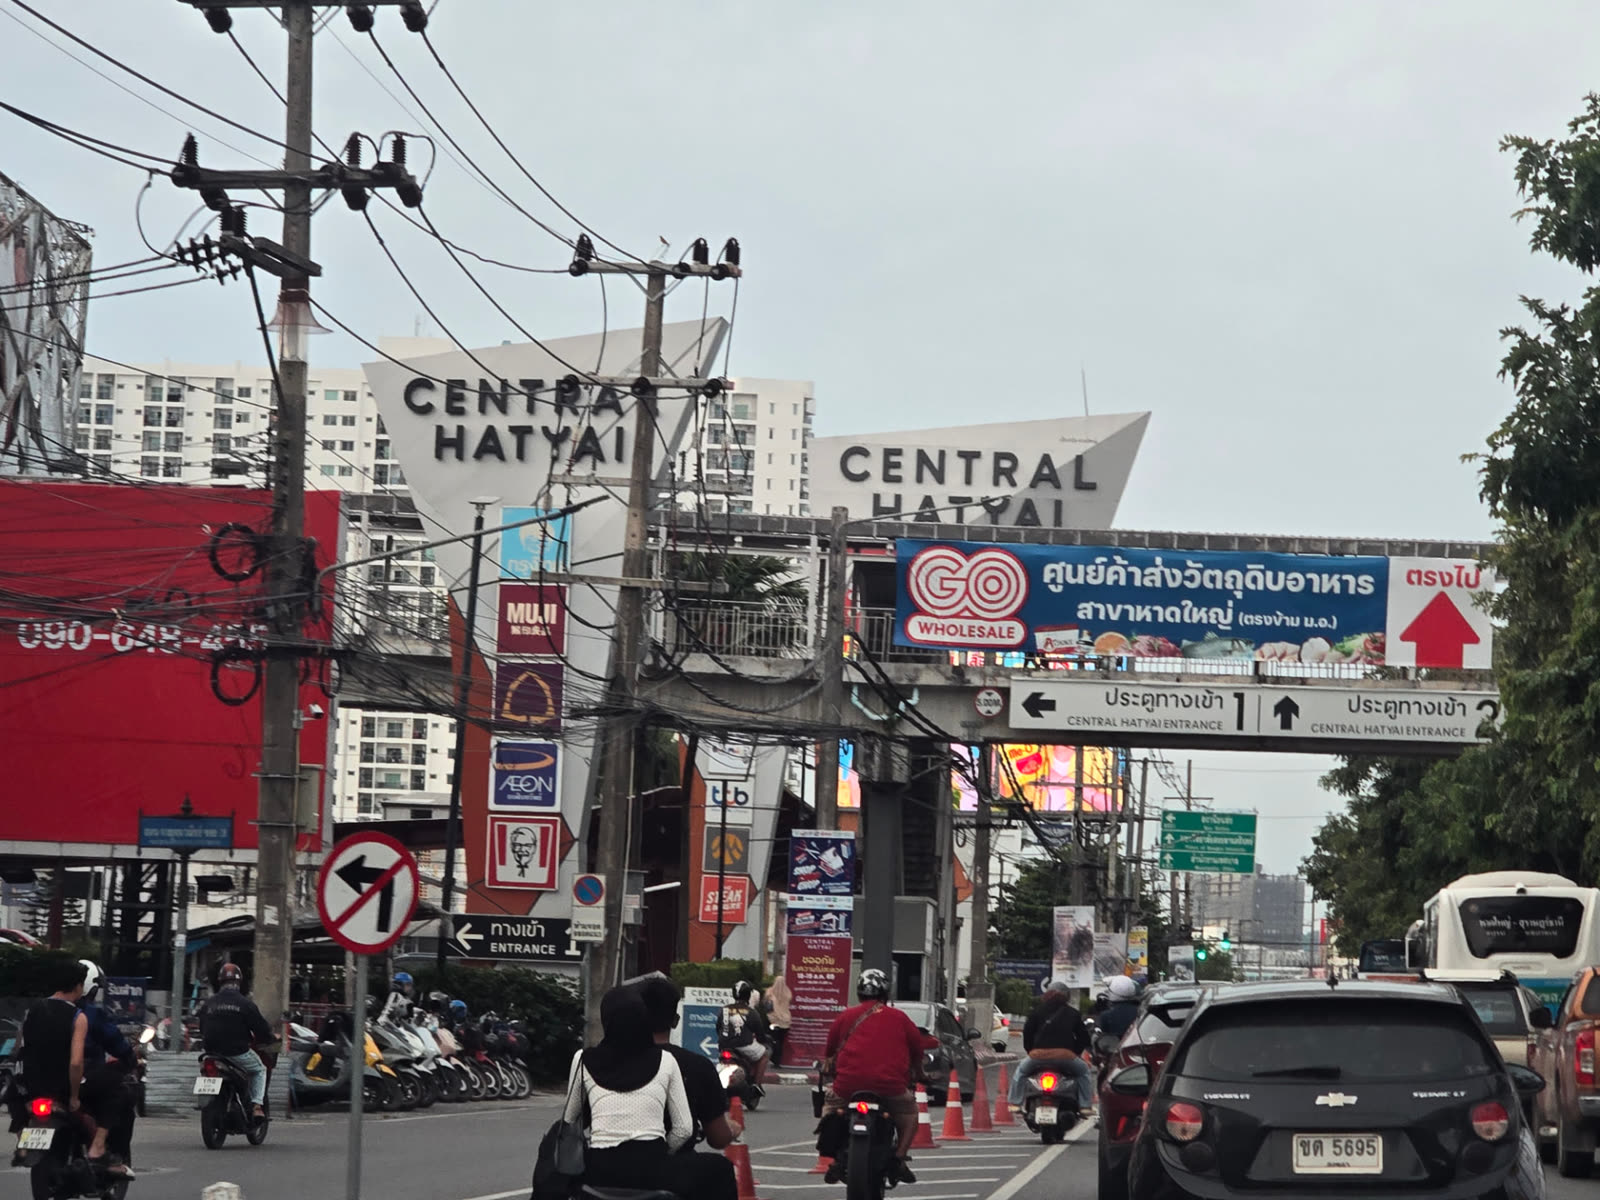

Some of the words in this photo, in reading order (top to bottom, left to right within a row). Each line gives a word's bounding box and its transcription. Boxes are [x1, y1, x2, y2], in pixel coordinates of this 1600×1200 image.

[404, 377, 660, 418] CENTRA
[434, 424, 625, 463] HATYAI
[840, 446, 1098, 491] CENTRAL
[906, 545, 1030, 621] GO
[1043, 555, 1375, 599] ศูนย์ค้าส่งวัตถุดิบอาหาร
[1406, 564, 1481, 589] ตรงไป
[507, 602, 557, 625] MUJI
[1076, 599, 1234, 630] สาขาหาดใหญ่
[917, 620, 1016, 640] WHOLESALE
[1106, 687, 1224, 713] ประตูทางเข้า
[1233, 692, 1245, 732] 1
[1348, 694, 1467, 720] ประตูทางเข้า
[1067, 715, 1117, 728] CENTRAL
[1120, 718, 1162, 730] HATYAI
[1164, 719, 1223, 732] ENTRANCE
[1311, 722, 1360, 735] CENTRAL
[1364, 725, 1404, 736] HATYAI
[1405, 726, 1466, 738] ENTRANCE
[490, 919, 545, 938] ทางเข้า
[490, 942, 556, 955] ENTRANCE
[1332, 1138, 1376, 1157] 5695
